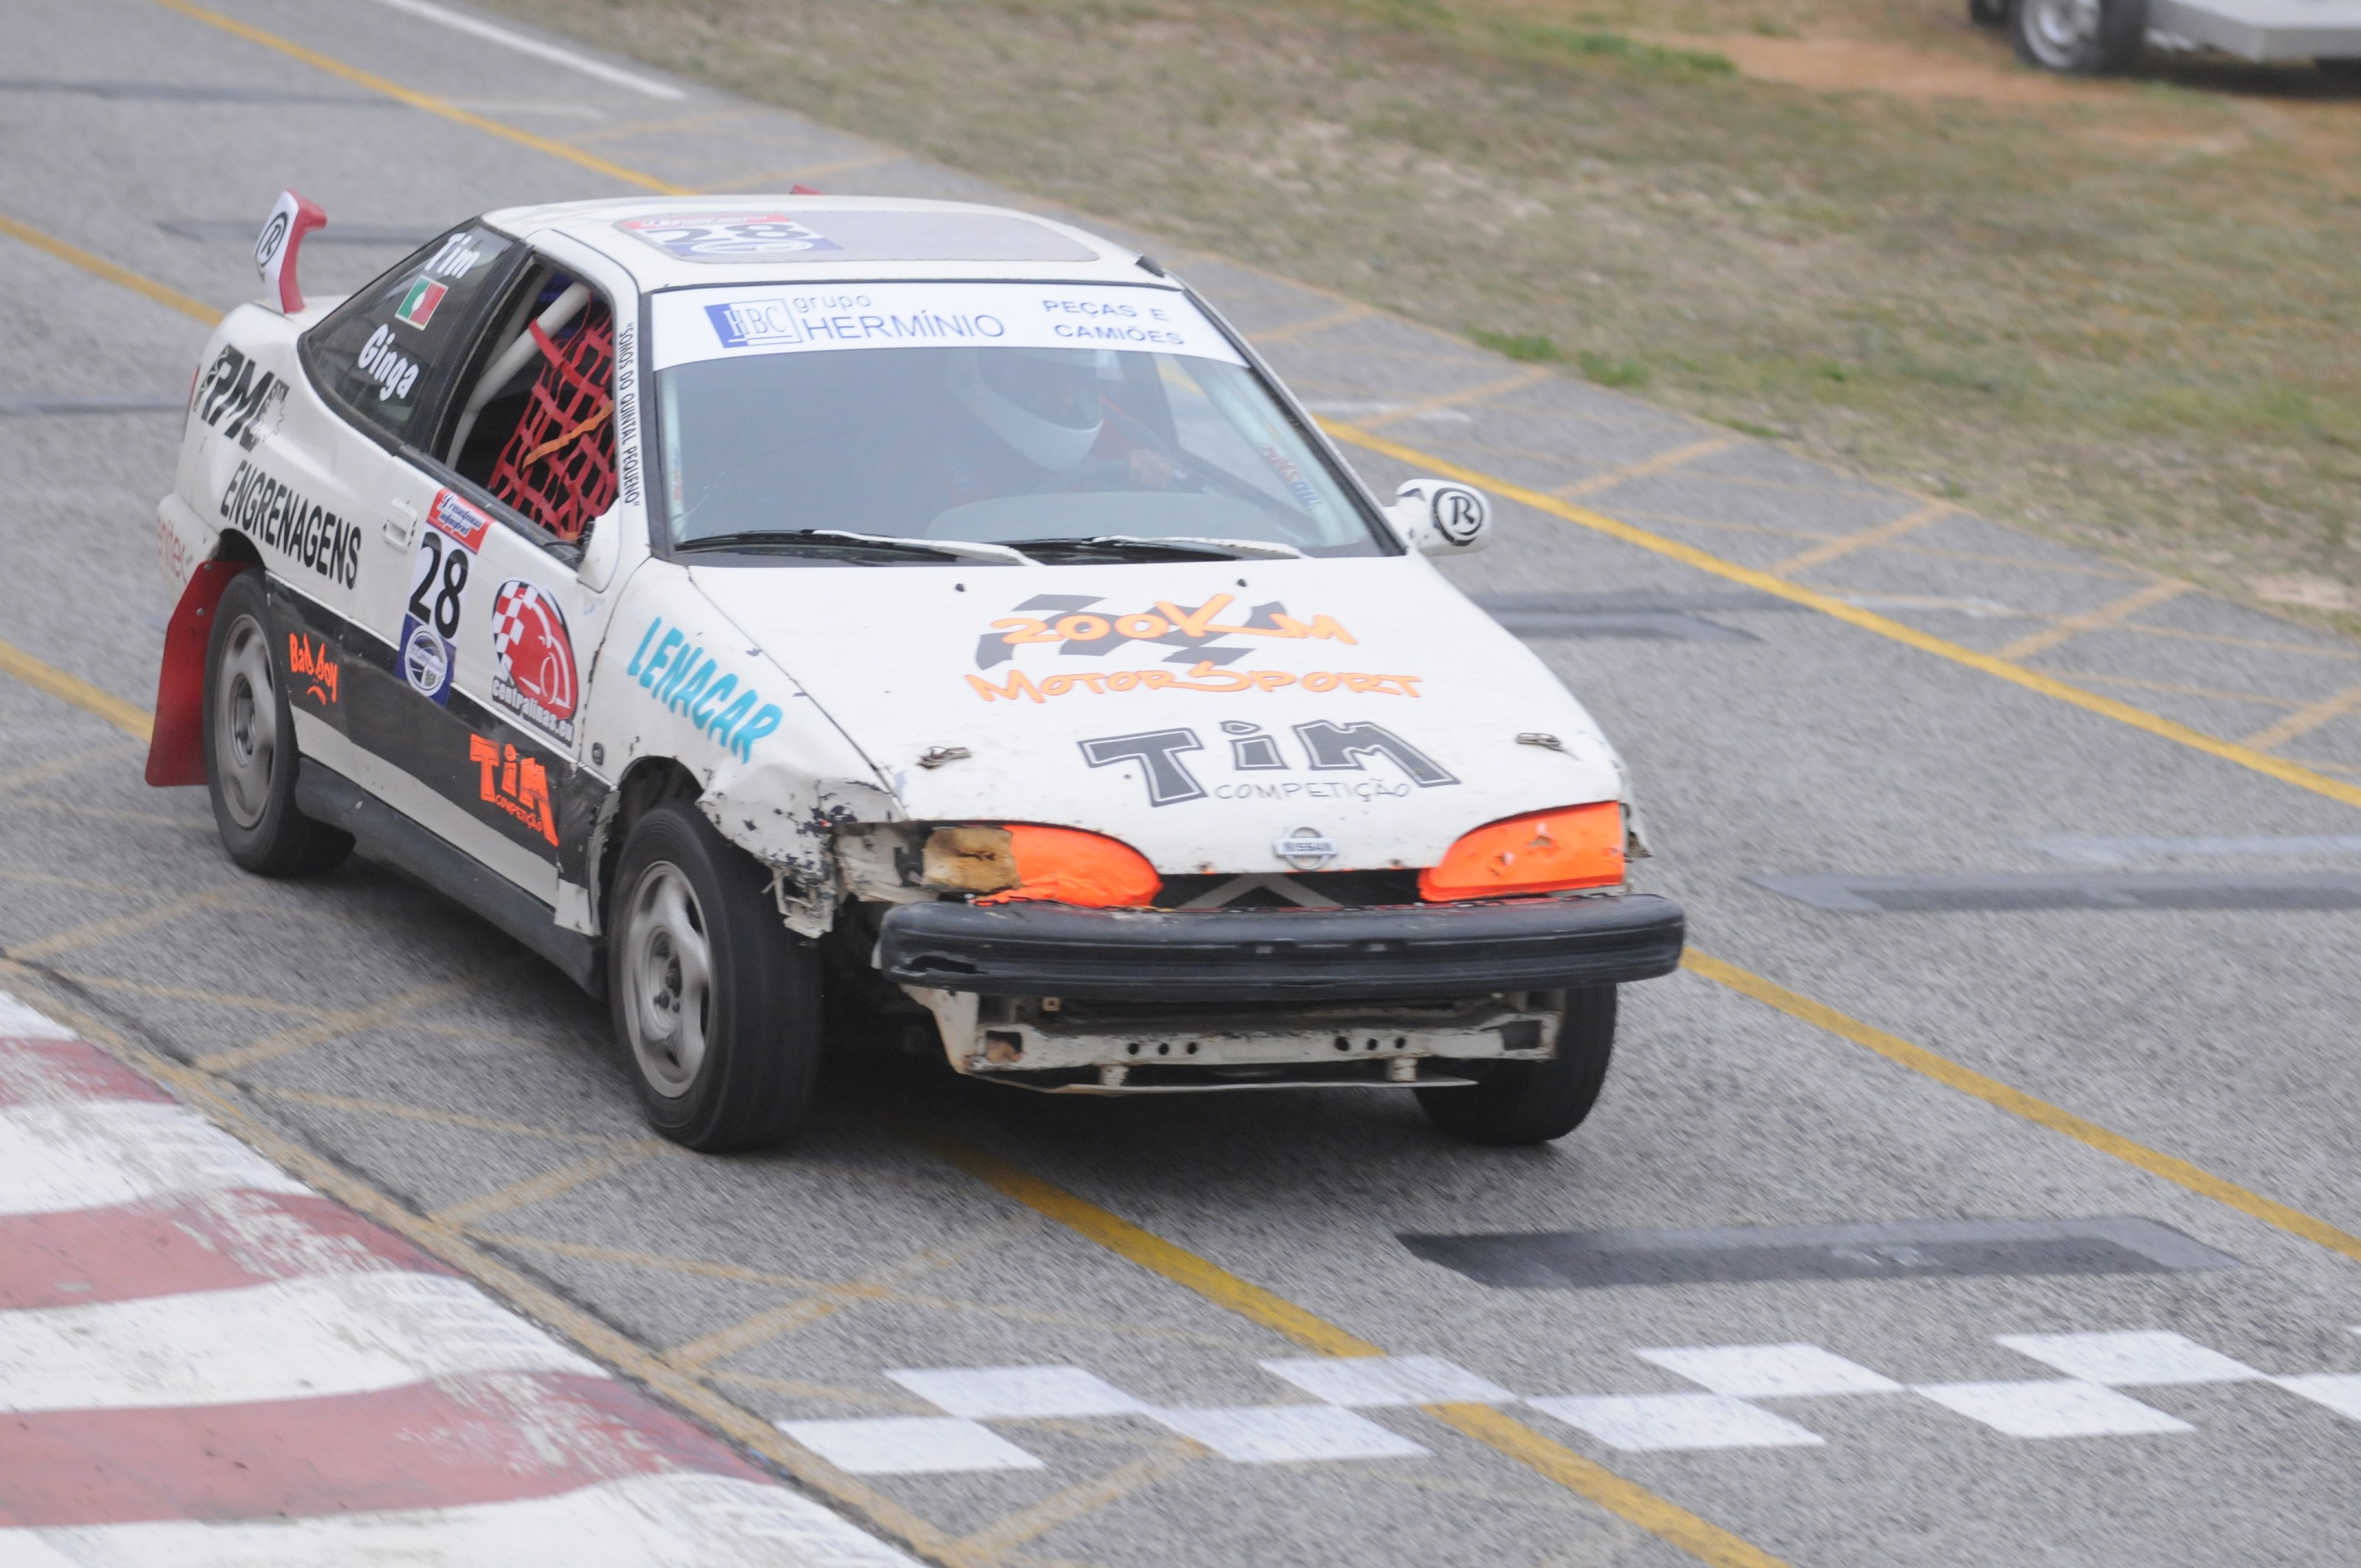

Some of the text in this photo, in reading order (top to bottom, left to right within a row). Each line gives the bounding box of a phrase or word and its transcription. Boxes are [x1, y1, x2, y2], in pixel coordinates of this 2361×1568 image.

[645, 223, 810, 243] 28
[424, 233, 481, 279] Tim
[793, 294, 871, 313] grupo
[1042, 300, 1170, 322] PEÇAS E
[801, 309, 1006, 341] HERMÍNIO
[1054, 324, 1184, 345] CAMIÕES
[358, 323, 420, 401] Ginga
[618, 369, 634, 391] DO
[620, 393, 638, 446] QUINTAL
[220, 459, 362, 591] ENGRENAGENS
[406, 531, 469, 640] 28
[626, 615, 784, 766] LENACAR
[493, 678, 574, 743] centralinas.eu
[1214, 777, 1411, 803] COMPETIÇÃO
